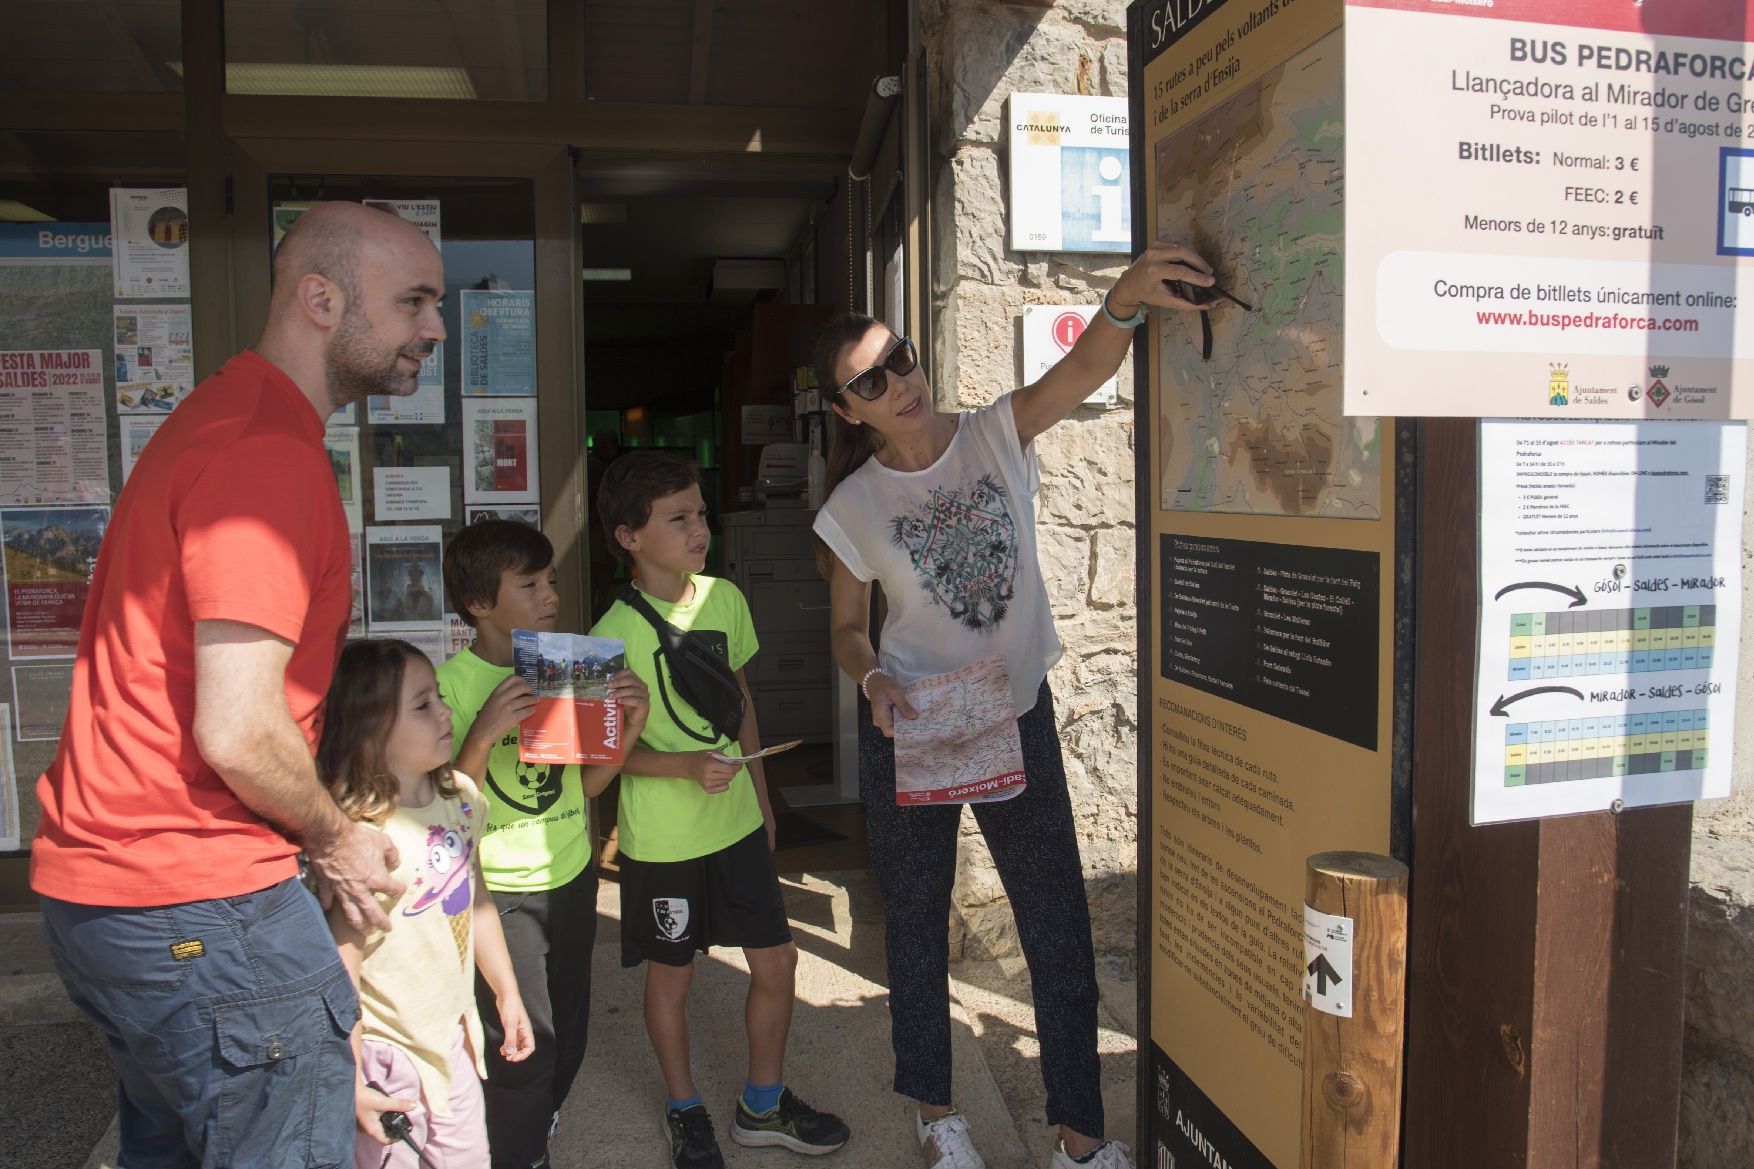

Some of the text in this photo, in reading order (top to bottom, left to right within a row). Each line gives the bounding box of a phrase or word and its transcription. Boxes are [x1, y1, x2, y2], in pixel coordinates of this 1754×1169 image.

[1152, 0, 1215, 48] SALD
[1154, 1, 1280, 100] 15 rutes a peu pels voltants
[1510, 37, 1567, 66] BUS
[1153, 56, 1240, 126] i de la serra d'Ensija
[1452, 69, 1575, 101] Llançadora
[1582, 81, 1599, 103] al
[1607, 83, 1688, 110] Mirador
[1694, 90, 1720, 112] de
[1016, 124, 1071, 133] CATALUNYA
[1090, 113, 1127, 124] Oficina
[1090, 126, 1103, 134] de
[1490, 104, 1536, 123] Prova
[1540, 108, 1573, 128] pilot
[1578, 112, 1598, 128] de
[1602, 113, 1618, 130] l'1
[1624, 114, 1638, 131] al
[1642, 116, 1660, 132] 15
[1664, 118, 1720, 139] d'agost
[1724, 122, 1742, 138] de
[1458, 141, 1639, 172] Bitllets: Normal: 3 €
[1564, 186, 1639, 205] FEEC: 2 €
[1464, 215, 1664, 241] Menors de 12 anys: gratuït
[487, 299, 530, 307] HORARIS
[1434, 279, 1737, 309] Compra de bitllets únicament online:
[479, 308, 530, 317] OBERTURA
[1476, 309, 1699, 332] www.buspedraforca.com
[0, 352, 90, 370] ESTA MAJOR
[470, 331, 479, 386] BIBLIOTECA
[479, 335, 488, 386] DE SALDES
[52, 374, 78, 386] 2022
[1573, 385, 1618, 396] Ajuntament
[1673, 385, 1717, 396] Ajuntament
[1573, 396, 1608, 405] de Saldes
[1673, 396, 1681, 404] de
[1160, 698, 1210, 727] RECOMANACIONS
[502, 735, 517, 748] de
[1162, 723, 1189, 744] Consulteu
[1235, 755, 1244, 768] de
[1245, 762, 1261, 776] cada
[1262, 768, 1279, 784] ruta.
[1162, 774, 1170, 785] No
[1171, 760, 1197, 783] important
[1198, 775, 1211, 789] anar
[1232, 792, 1284, 828] adequadament.
[1189, 752, 1201, 767] guia
[1202, 759, 1230, 781] detallada
[1231, 772, 1239, 785] de
[1240, 778, 1257, 793] cada
[1259, 786, 1295, 812] caminada.
[1162, 790, 1190, 812] Respecteu
[1225, 823, 1234, 839] les
[1236, 831, 1262, 855] plantes.
[1221, 882, 1256, 911] ascensions
[1259, 906, 1265, 917] al
[1227, 864, 1287, 913] desenvolupament
[1225, 899, 1243, 919] algun
[1263, 925, 1290, 951] d'altres
[1221, 928, 1294, 992] incompatible en cap
[1249, 934, 1277, 960] guia. La
[1236, 959, 1252, 978] seus
[1224, 964, 1303, 1034] zones de mitjana alta
[1247, 999, 1284, 1037] variabilitat
[1250, 1020, 1277, 1048] grau de
